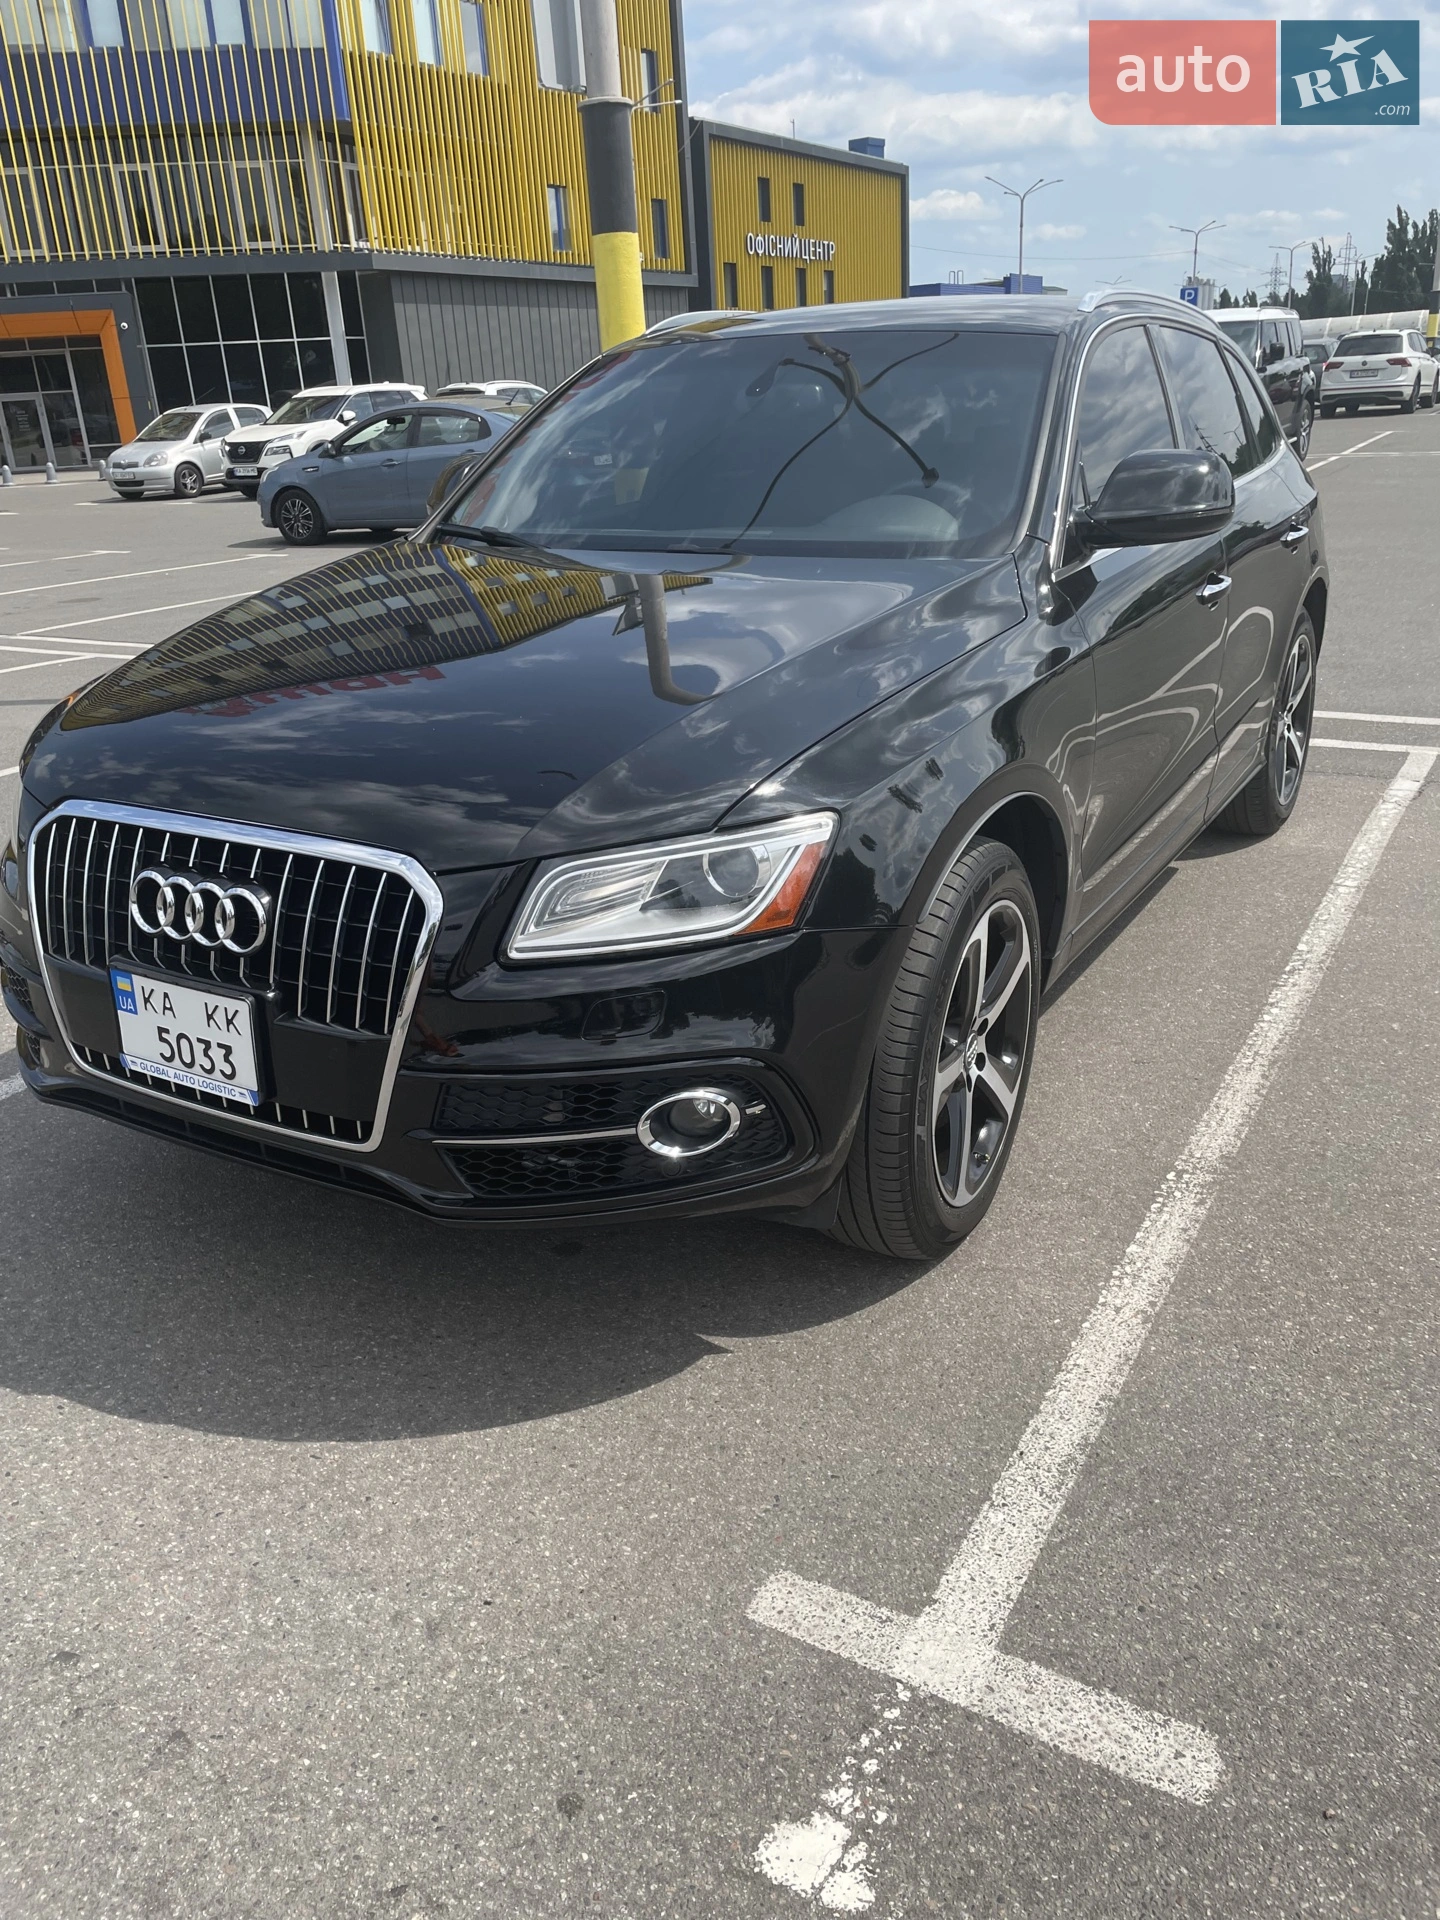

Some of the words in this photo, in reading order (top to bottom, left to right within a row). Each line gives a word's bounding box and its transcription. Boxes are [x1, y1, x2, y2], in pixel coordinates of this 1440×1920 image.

[747, 232, 800, 259] ОФІСНИЙ
[801, 238, 835, 264] ЦЕНТР
[1185, 290, 1195, 302] P
[119, 995, 135, 1012] UA
[141, 985, 177, 1019] KA
[204, 1001, 242, 1036] KK
[156, 1025, 237, 1081] 5033
[139, 1061, 172, 1079] GLOBAL
[173, 1071, 196, 1086] AUTO
[197, 1078, 237, 1098] LOGISTIC
